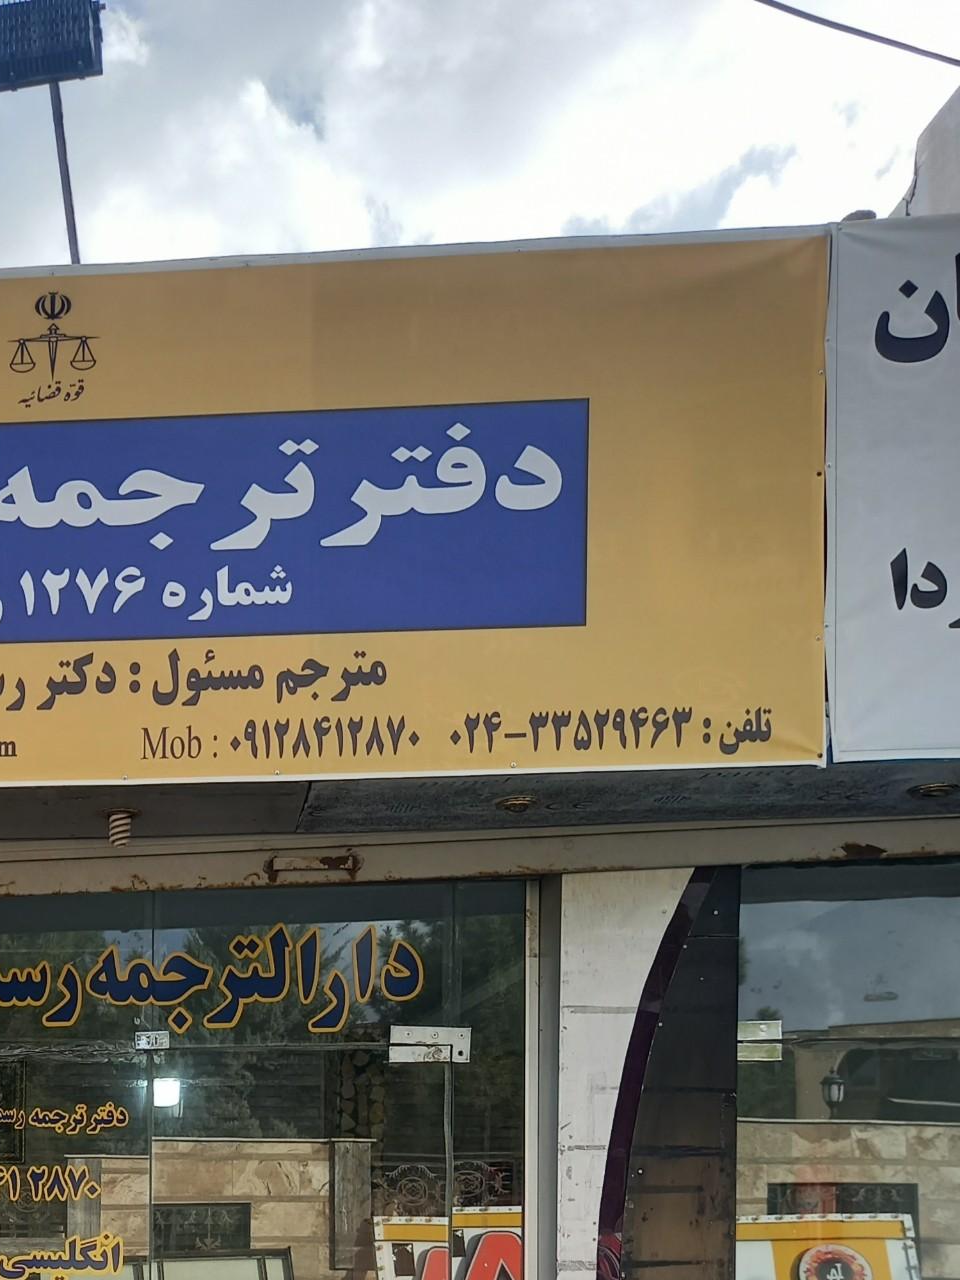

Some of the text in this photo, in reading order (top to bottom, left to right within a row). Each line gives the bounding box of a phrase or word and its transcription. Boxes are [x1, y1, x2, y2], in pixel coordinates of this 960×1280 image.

[319, 421, 563, 548] دفتر
[19, 566, 146, 617] ۱۲۷۶
[161, 563, 293, 622] شماره
[36, 651, 117, 711] دکتر
[276, 650, 388, 704] مترجم
[229, 714, 421, 760] ۰۹۱۲۸۴۱۲۸۷۰
[86, 1101, 129, 1135] دفتر
